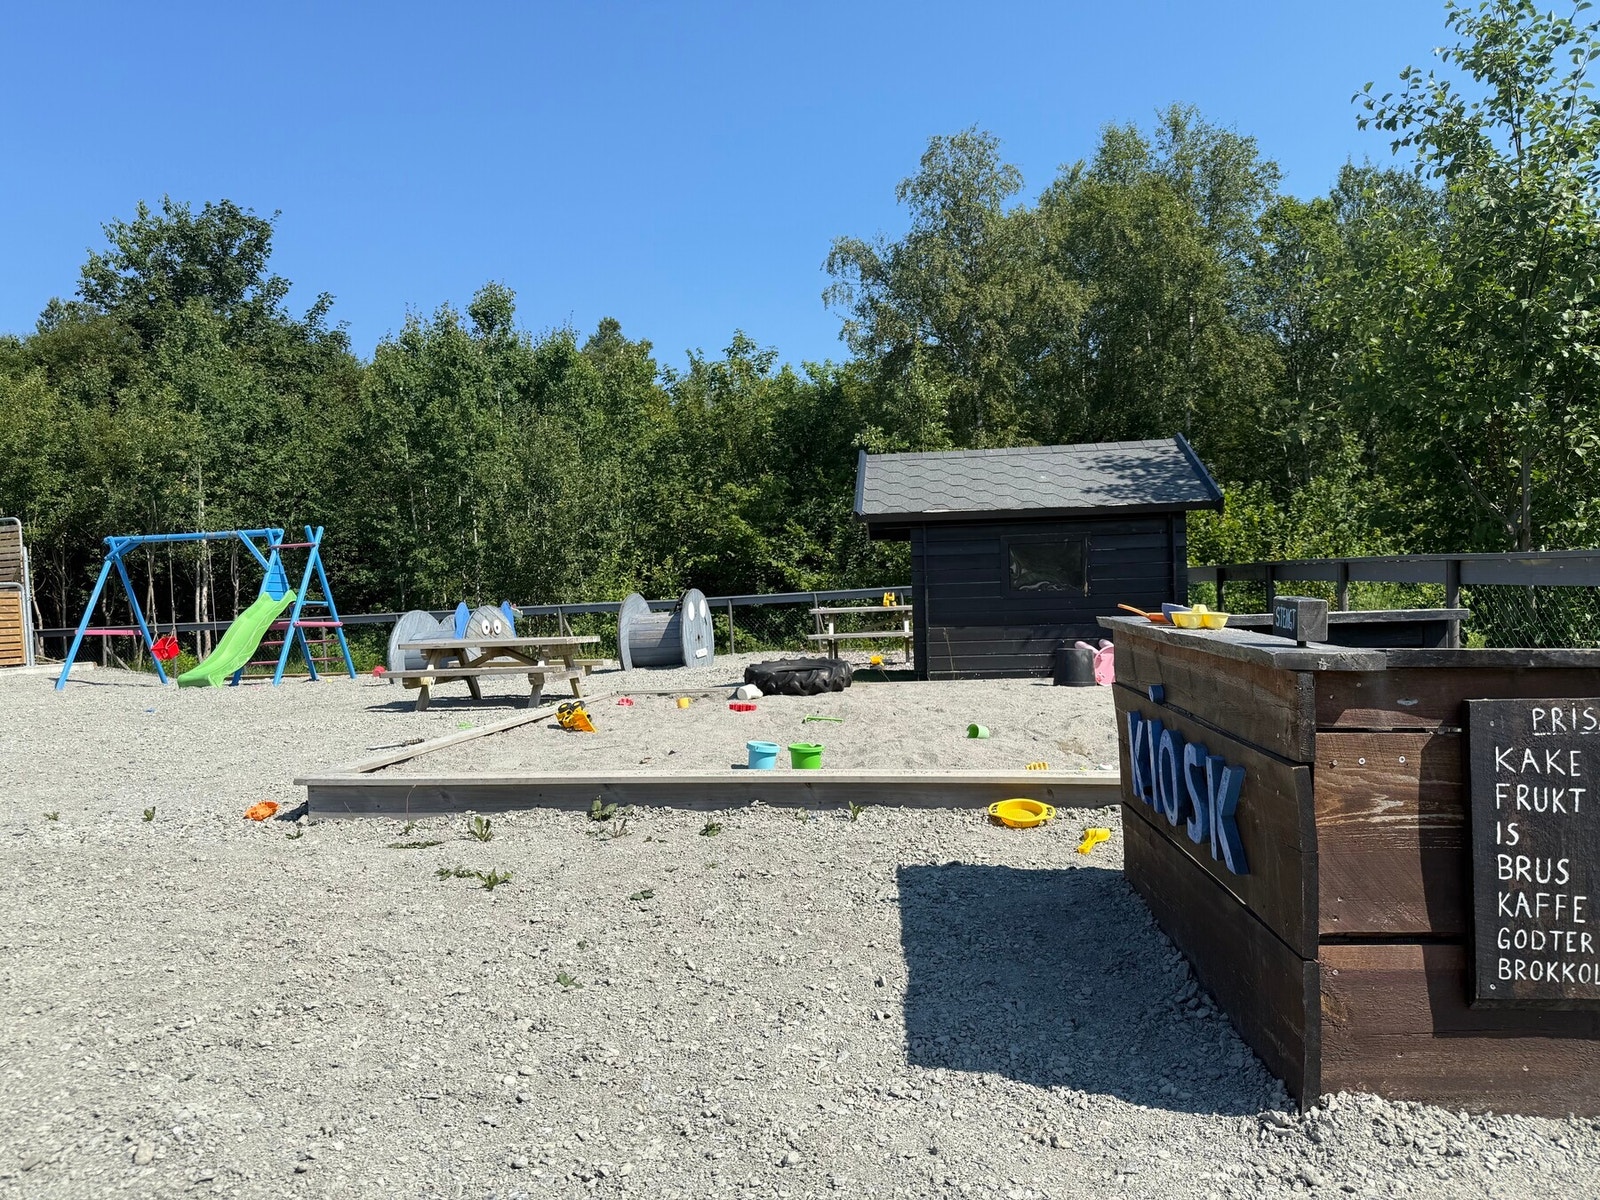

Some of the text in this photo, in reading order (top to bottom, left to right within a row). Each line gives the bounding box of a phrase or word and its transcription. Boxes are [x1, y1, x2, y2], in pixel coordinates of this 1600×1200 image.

[1532, 702, 1600, 732] PRIS
[1495, 746, 1582, 777] KAKE
[1126, 685, 1250, 876] KIOSK
[1495, 783, 1587, 814] FRUKT
[1496, 821, 1520, 846] IS
[1497, 854, 1570, 885] BRUS
[1498, 891, 1587, 924] KAFFE
[1497, 927, 1595, 954] GODTER
